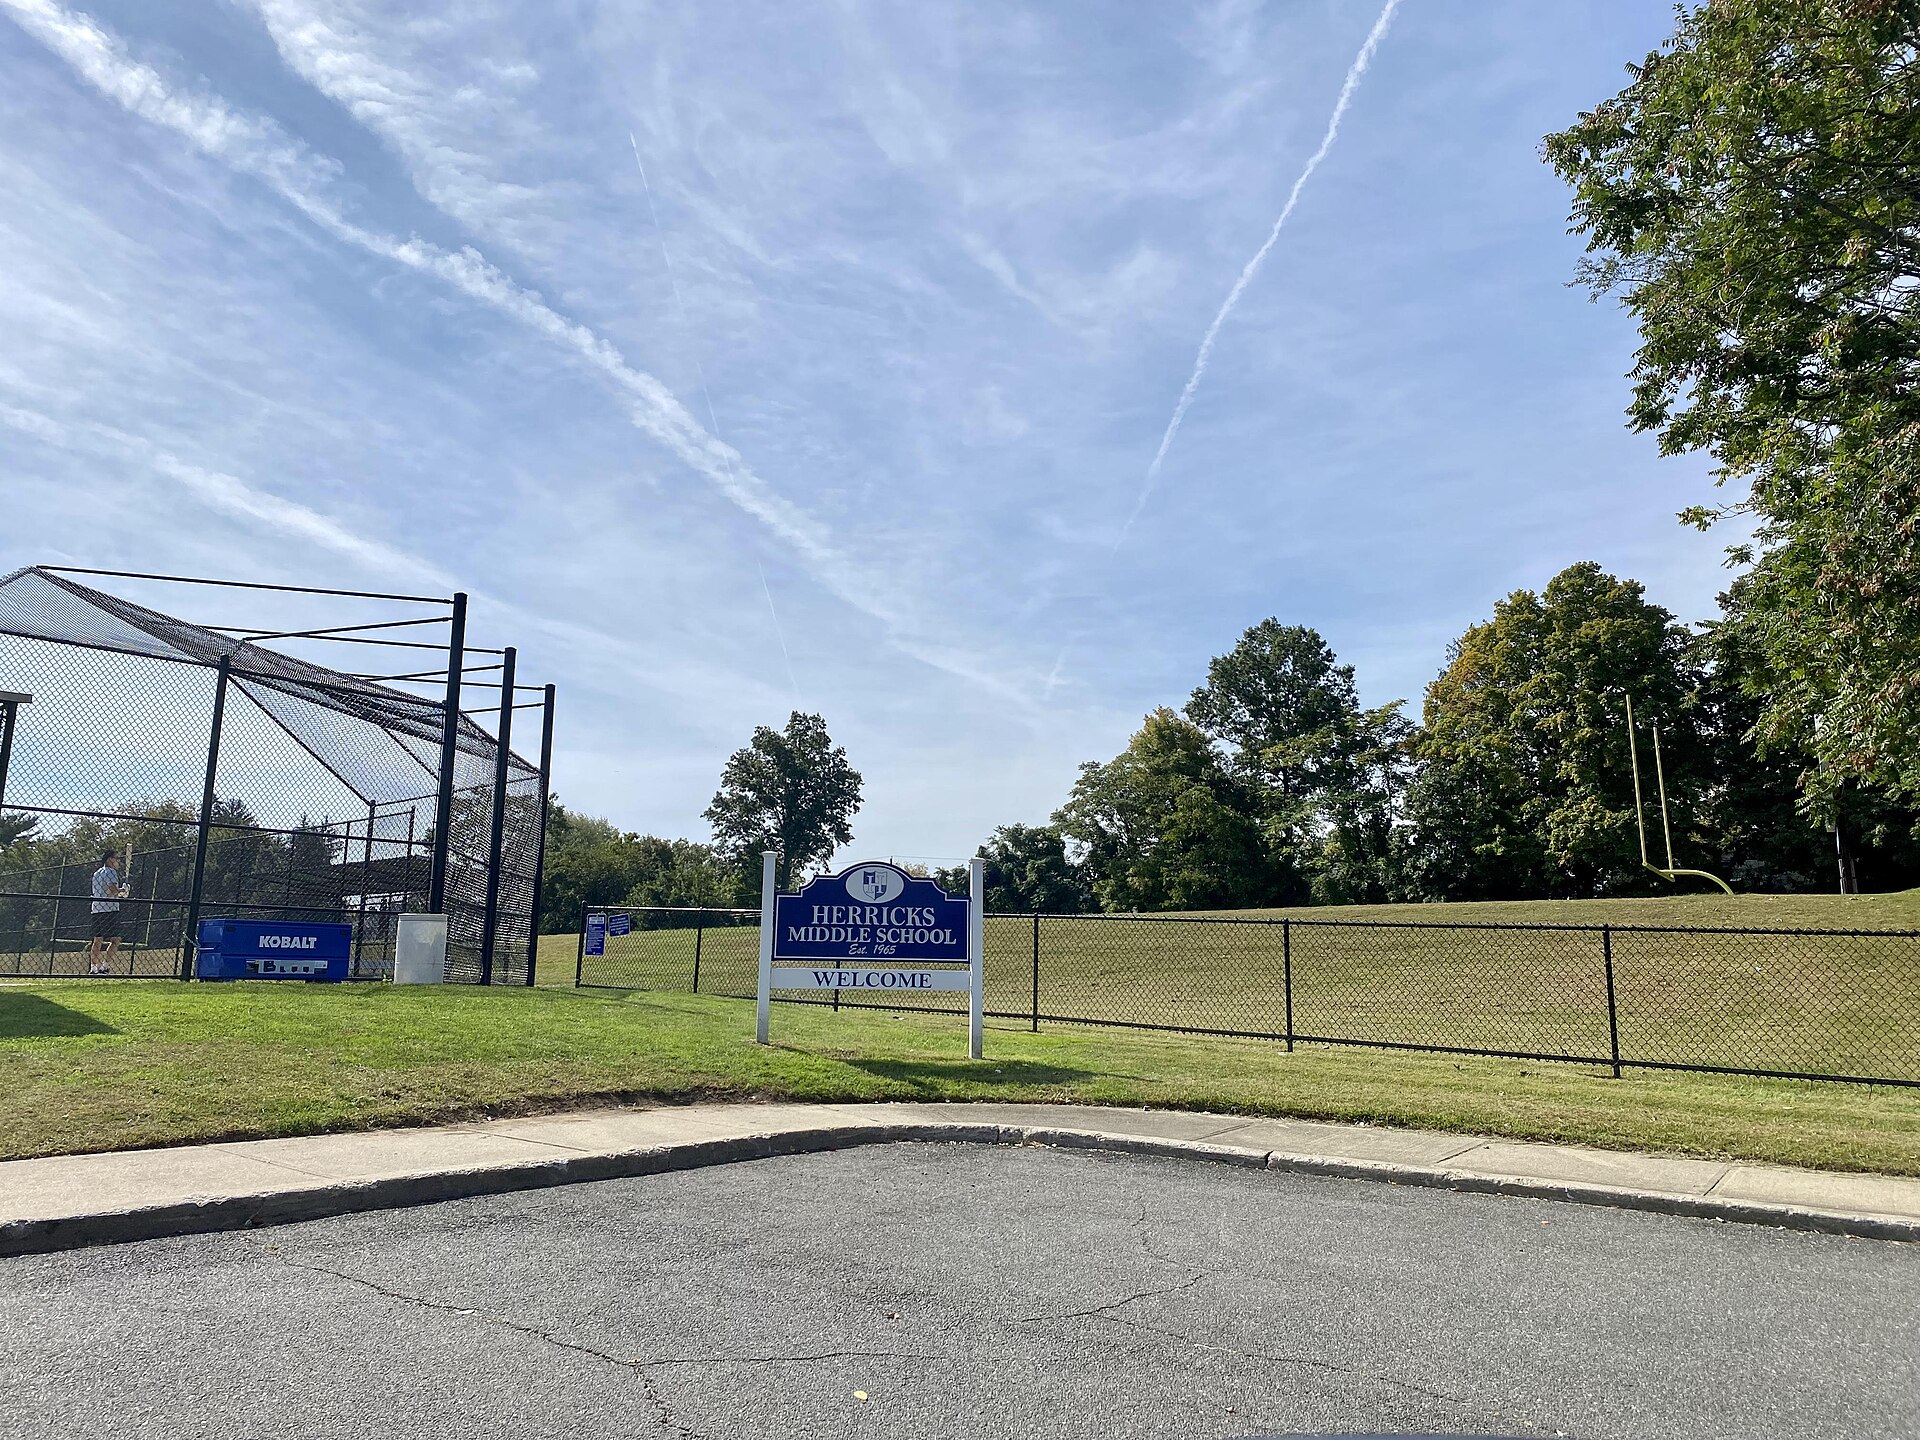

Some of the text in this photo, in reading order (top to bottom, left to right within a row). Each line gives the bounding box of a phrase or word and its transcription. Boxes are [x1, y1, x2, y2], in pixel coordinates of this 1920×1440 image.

[811, 905, 935, 927] HERRICKS
[258, 935, 317, 949] KOBALT
[787, 926, 957, 945] MIDDLE SCHOOL
[848, 943, 897, 955] Est. 1965
[812, 971, 933, 989] WELCOME
